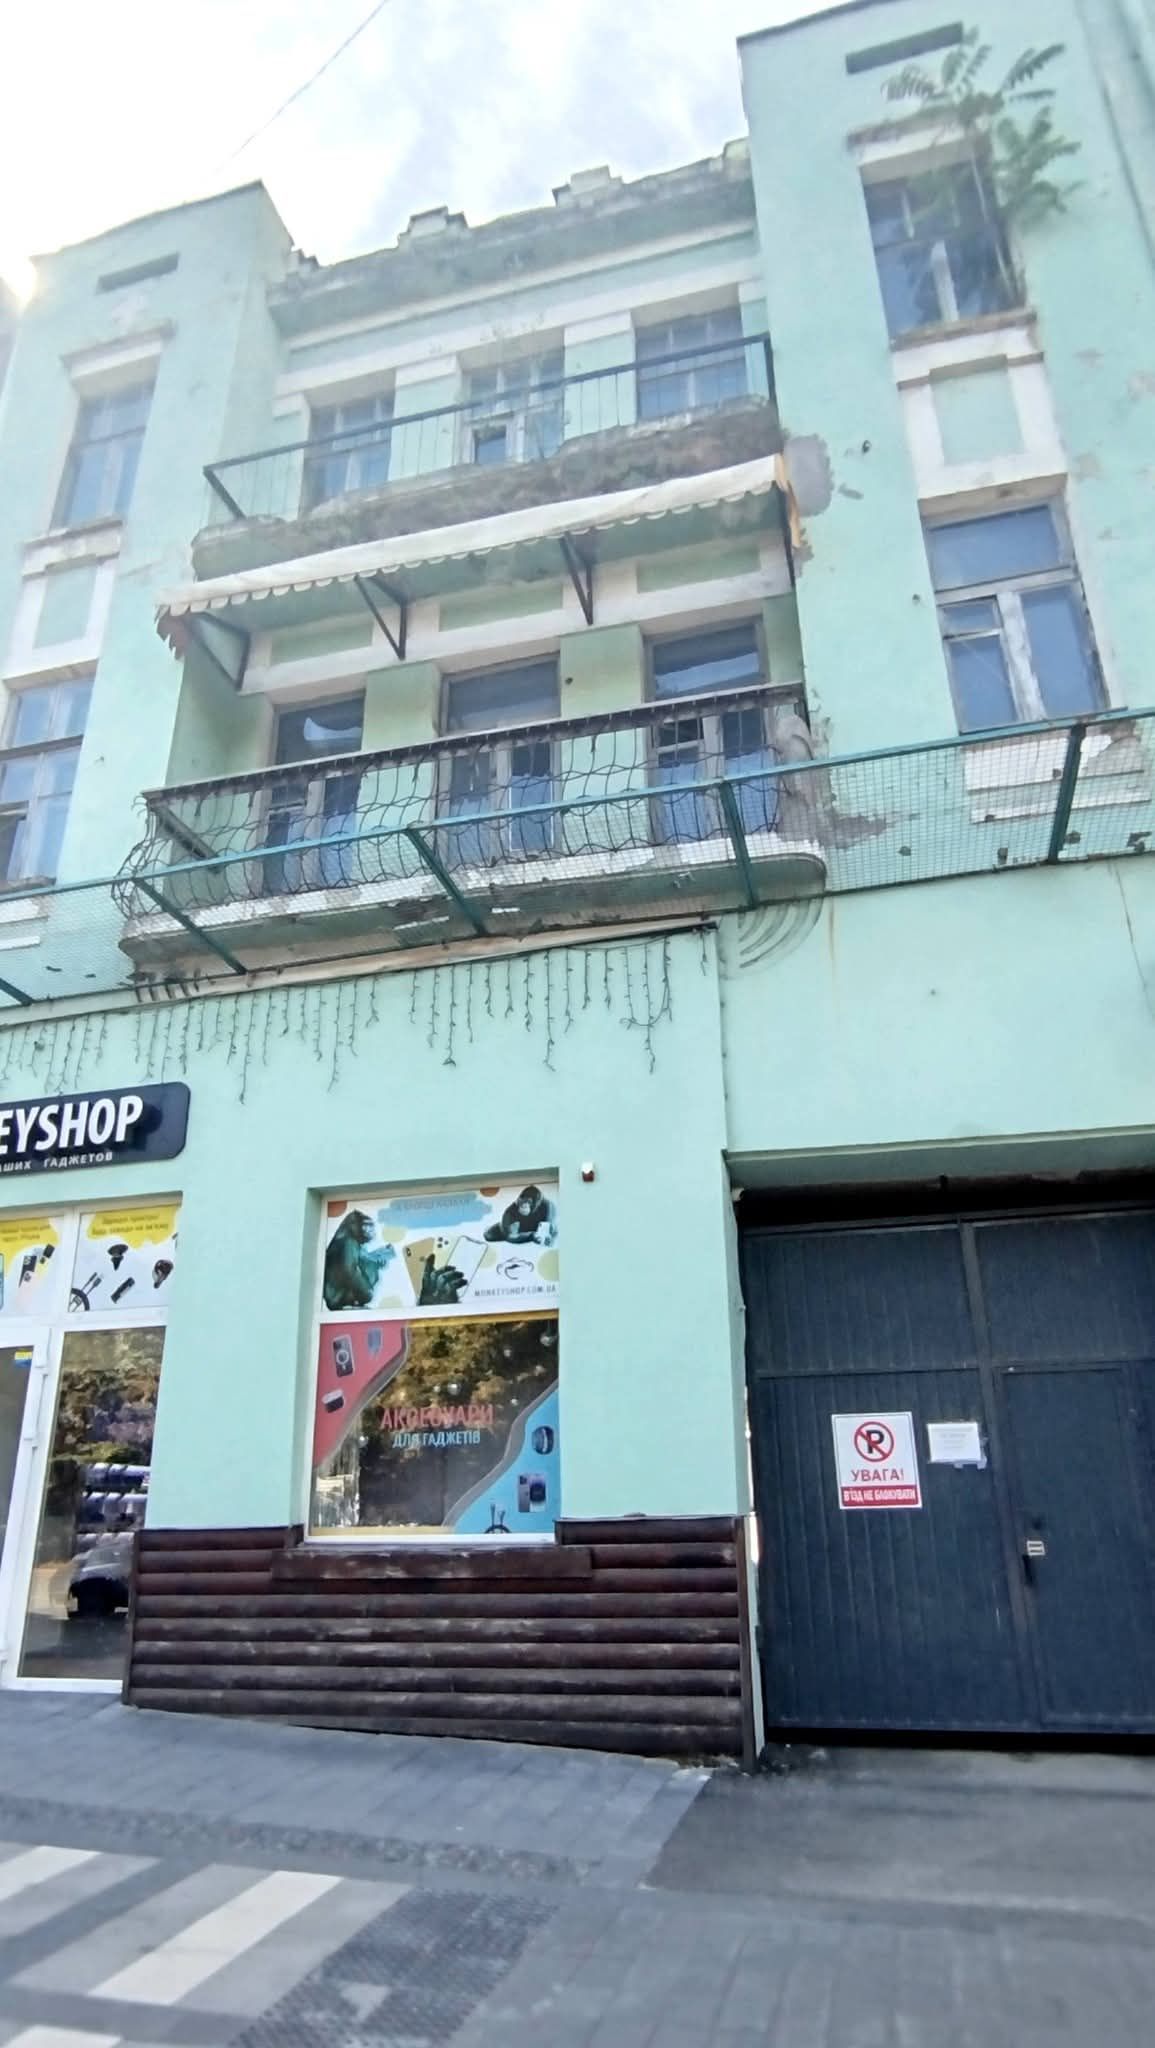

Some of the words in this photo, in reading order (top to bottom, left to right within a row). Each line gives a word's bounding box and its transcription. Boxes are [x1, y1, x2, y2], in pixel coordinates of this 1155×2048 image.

[0, 1095, 143, 1155] EYSHOP
[0, 1161, 31, 1173] ШИХ
[44, 1152, 113, 1168] ГАДЖЕТОВ
[392, 1431, 419, 1448] ДЛЯ
[422, 1430, 481, 1447] ГАДЖЕТІВ
[851, 1468, 904, 1481] УВАГА!
[864, 1489, 873, 1501] НЕ
